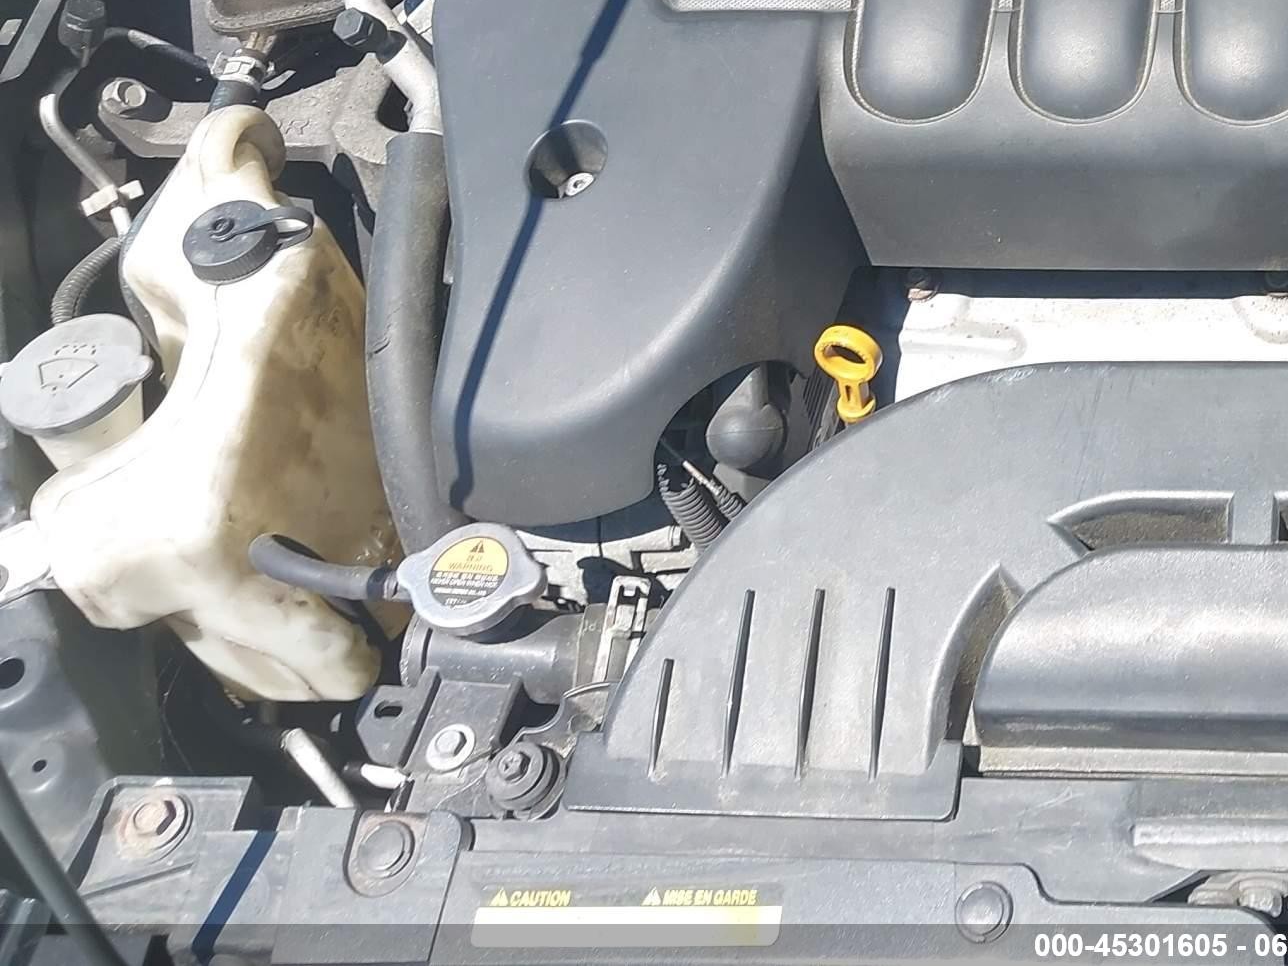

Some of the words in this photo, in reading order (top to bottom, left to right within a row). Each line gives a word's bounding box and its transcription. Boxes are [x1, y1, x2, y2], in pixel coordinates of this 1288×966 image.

[449, 562, 494, 572] WARNING
[509, 890, 571, 906] CAUTION
[662, 890, 693, 906] MISE
[693, 890, 713, 906] EN
[713, 890, 758, 906] GARDE
